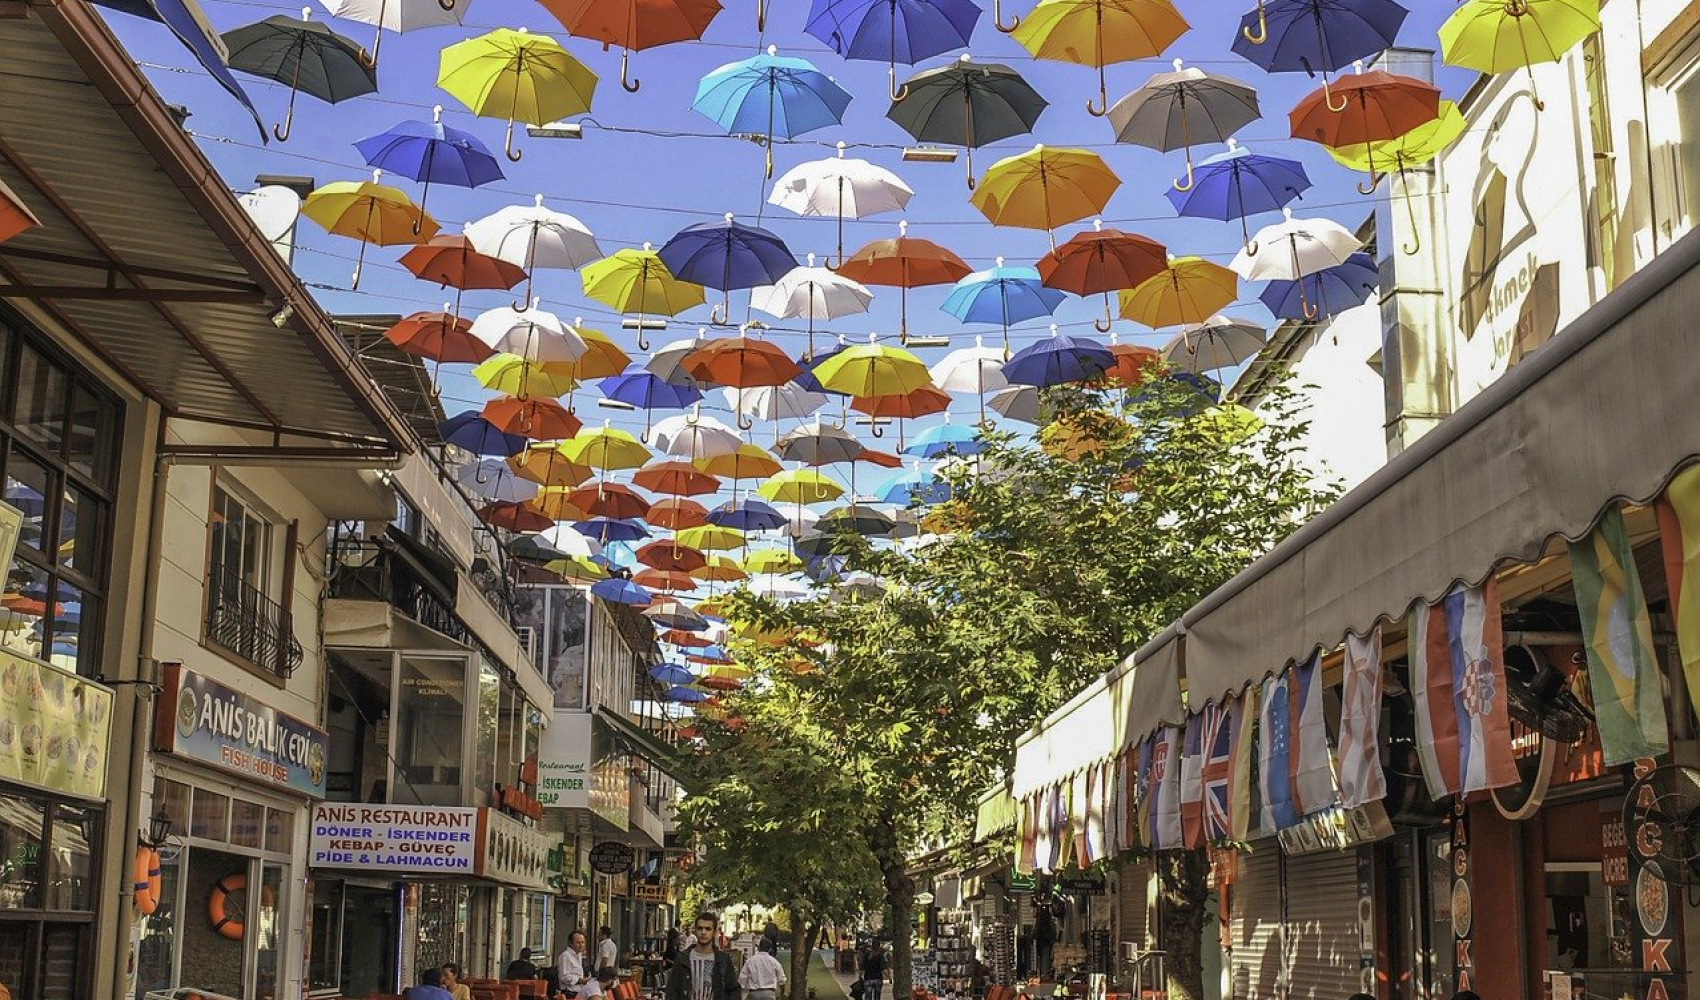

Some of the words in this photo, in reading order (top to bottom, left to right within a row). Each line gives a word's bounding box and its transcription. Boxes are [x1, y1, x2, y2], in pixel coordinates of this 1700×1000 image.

[199, 693, 244, 739] ANİS
[221, 744, 250, 770] FISH
[252, 755, 288, 783] HOUSE
[543, 775, 584, 791] İSKENDER
[315, 805, 356, 823] ANİS
[361, 809, 473, 828] RESTAURANT
[316, 825, 373, 839] DÖNER
[387, 827, 470, 842] İSKENDER
[329, 839, 384, 852] KEBAP
[399, 841, 455, 856] GÜVEÇ
[316, 850, 354, 864] PİDE
[358, 854, 370, 864] &
[376, 855, 468, 868] LAHMACUN
